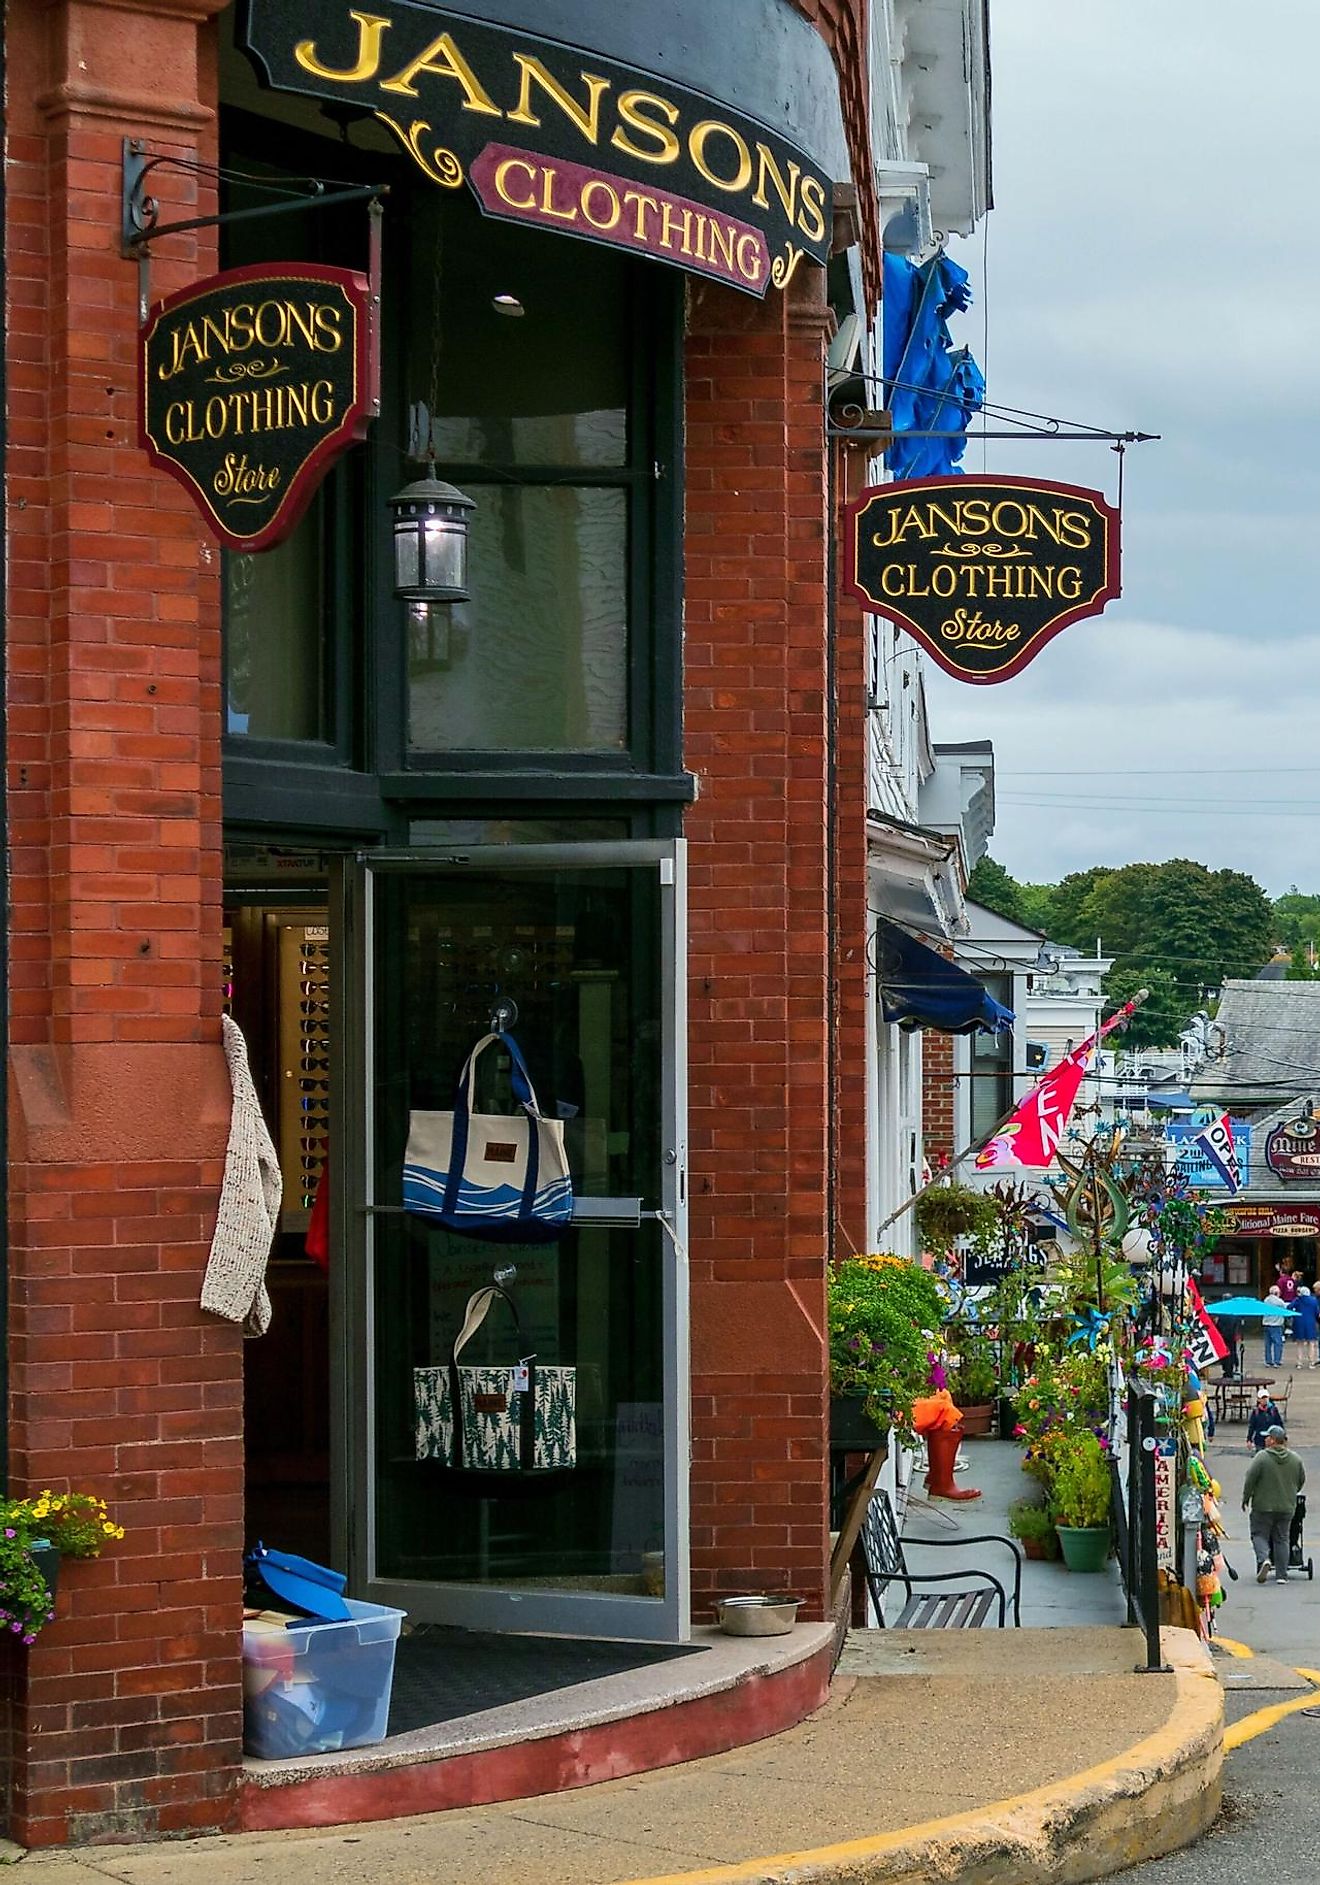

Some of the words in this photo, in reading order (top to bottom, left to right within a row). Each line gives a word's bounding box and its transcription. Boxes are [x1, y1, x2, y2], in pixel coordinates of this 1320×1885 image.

[294, 8, 827, 244] JANSONS
[493, 158, 763, 283] CLOTHING
[158, 300, 343, 380] JANSONS
[165, 380, 334, 445] CLOTHING
[213, 452, 281, 496] Store
[872, 500, 1092, 550] JANSONS
[880, 564, 1084, 600] CLOTHING
[940, 608, 1022, 642] Store
[1171, 1135, 1197, 1145] LAZ
[1210, 1127, 1242, 1187] OPEN
[1271, 1138, 1317, 1153] Mine
[1272, 1214, 1299, 1226] Maine
[1300, 1212, 1319, 1225] Fare
[1155, 1460, 1170, 1549] AMERICA
